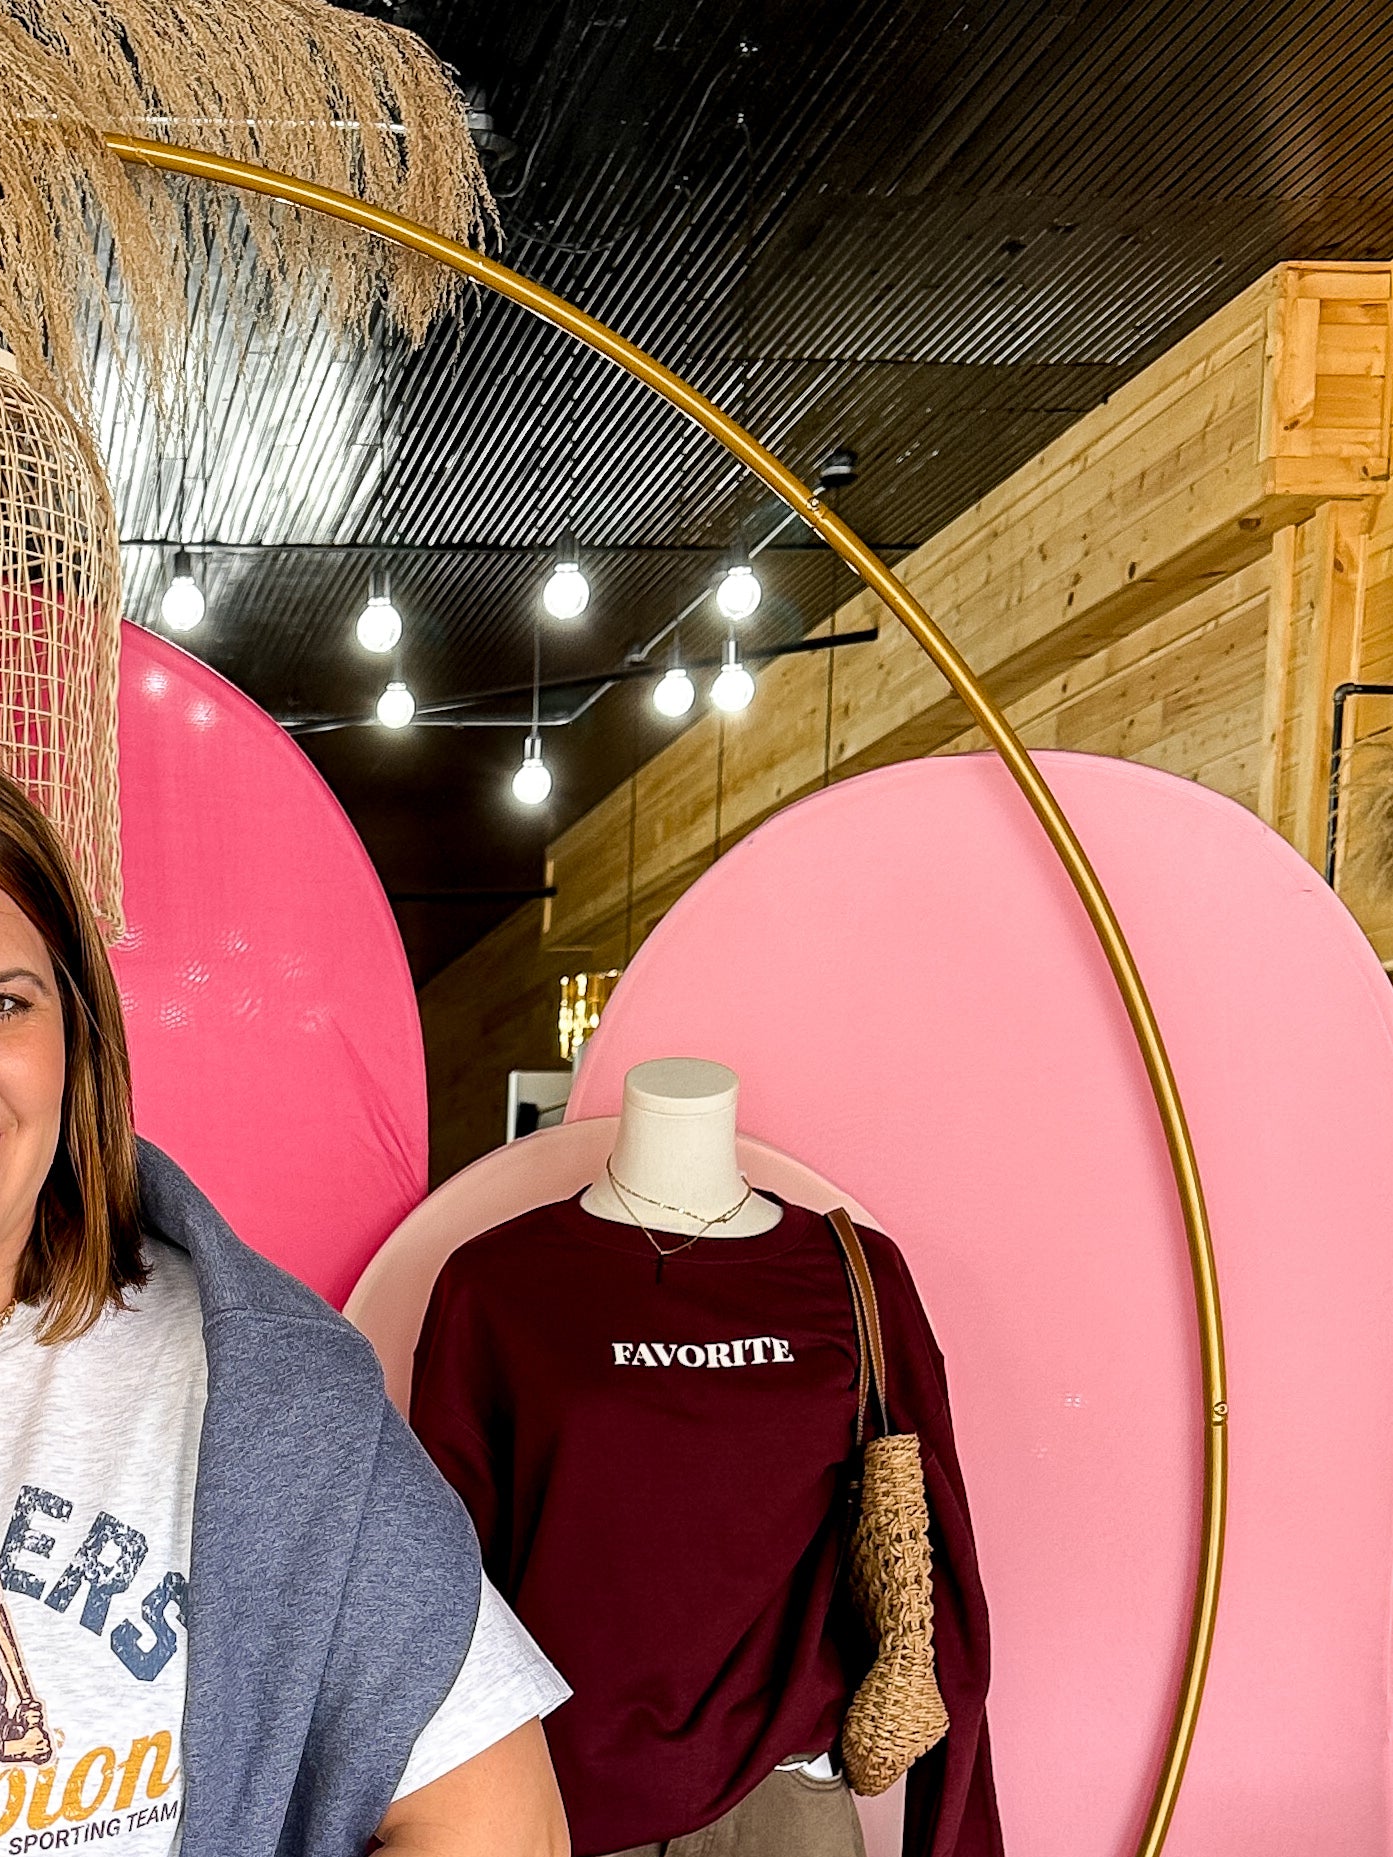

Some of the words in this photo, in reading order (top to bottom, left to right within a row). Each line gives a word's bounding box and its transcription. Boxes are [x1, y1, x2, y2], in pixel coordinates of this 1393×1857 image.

[612, 1336, 795, 1368] FAVORITE
[8, 1819, 121, 1855] SPORTING
[126, 1800, 179, 1832] TEAM
